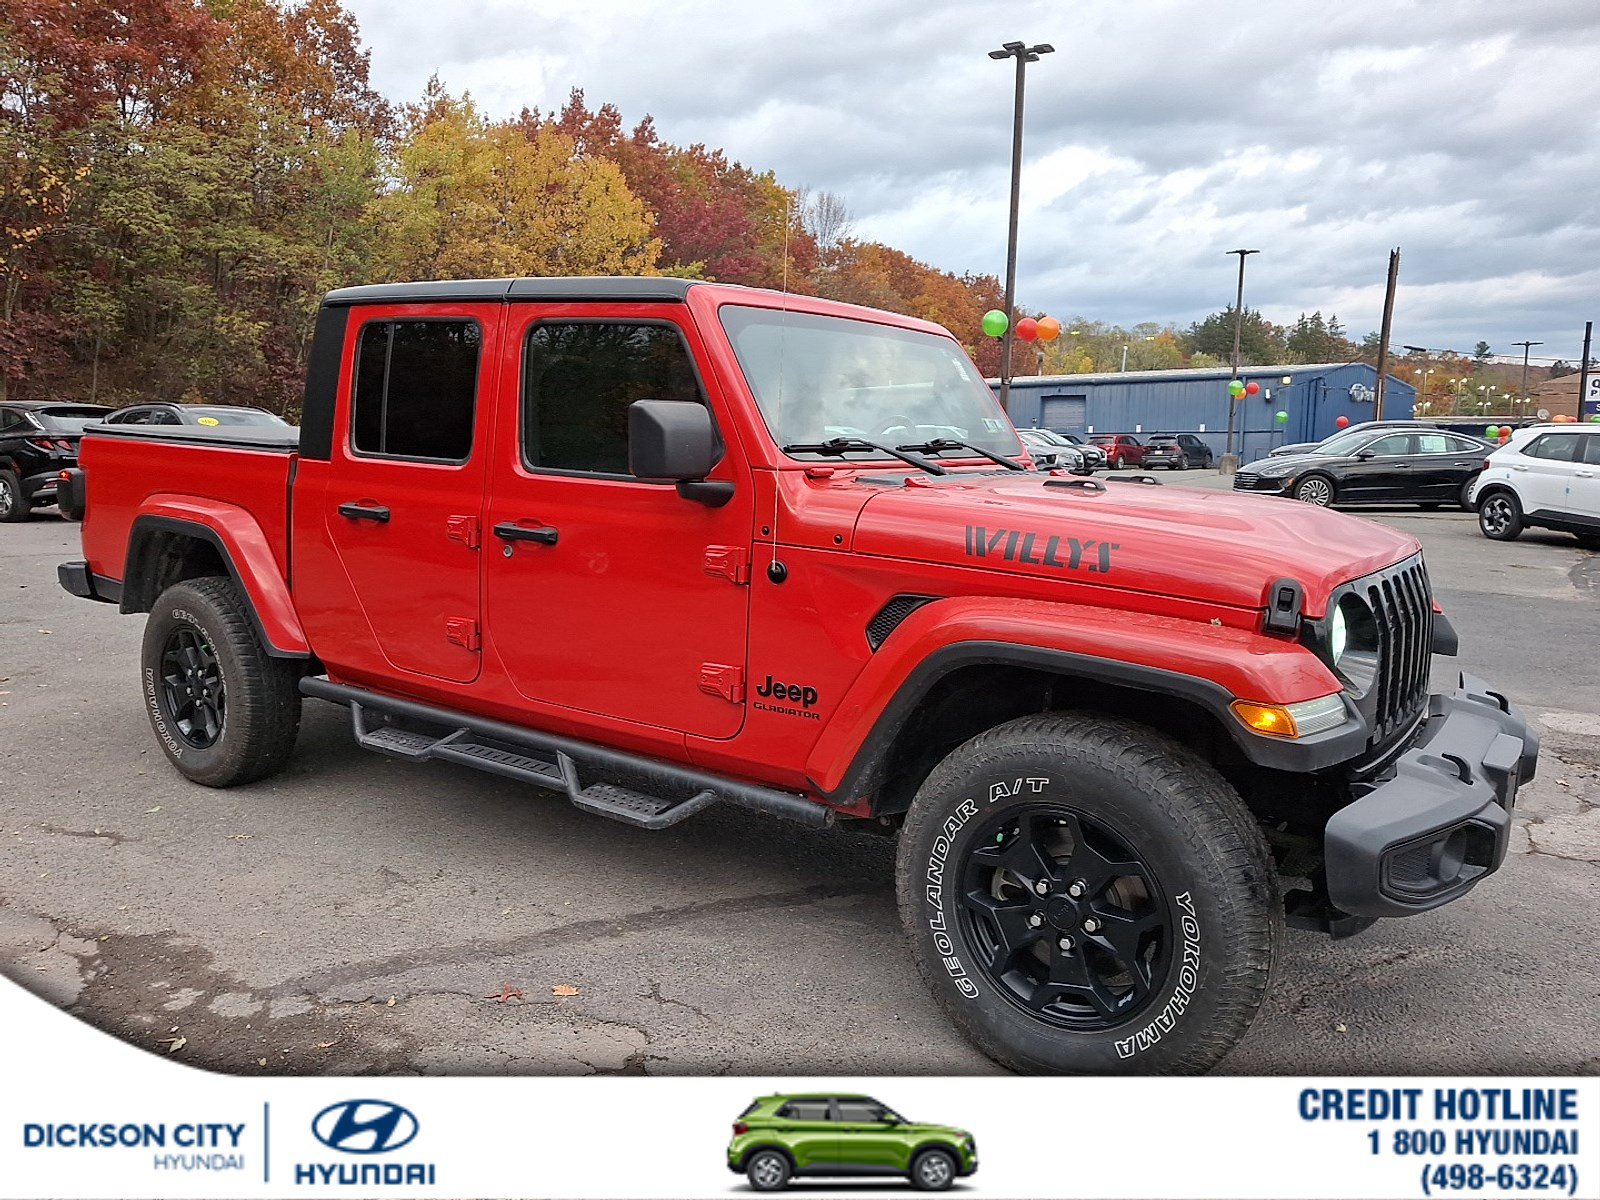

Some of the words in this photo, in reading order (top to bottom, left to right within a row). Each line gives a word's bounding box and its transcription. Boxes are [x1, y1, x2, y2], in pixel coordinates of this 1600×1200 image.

[966, 525, 1120, 573] WILLYS
[753, 702, 820, 720] GLADIATOR
[756, 675, 818, 708] Jeep
[926, 799, 980, 1000] GEOLANDAR
[989, 777, 1050, 803] A/T
[1114, 891, 1201, 1059] YOKOHAMA
